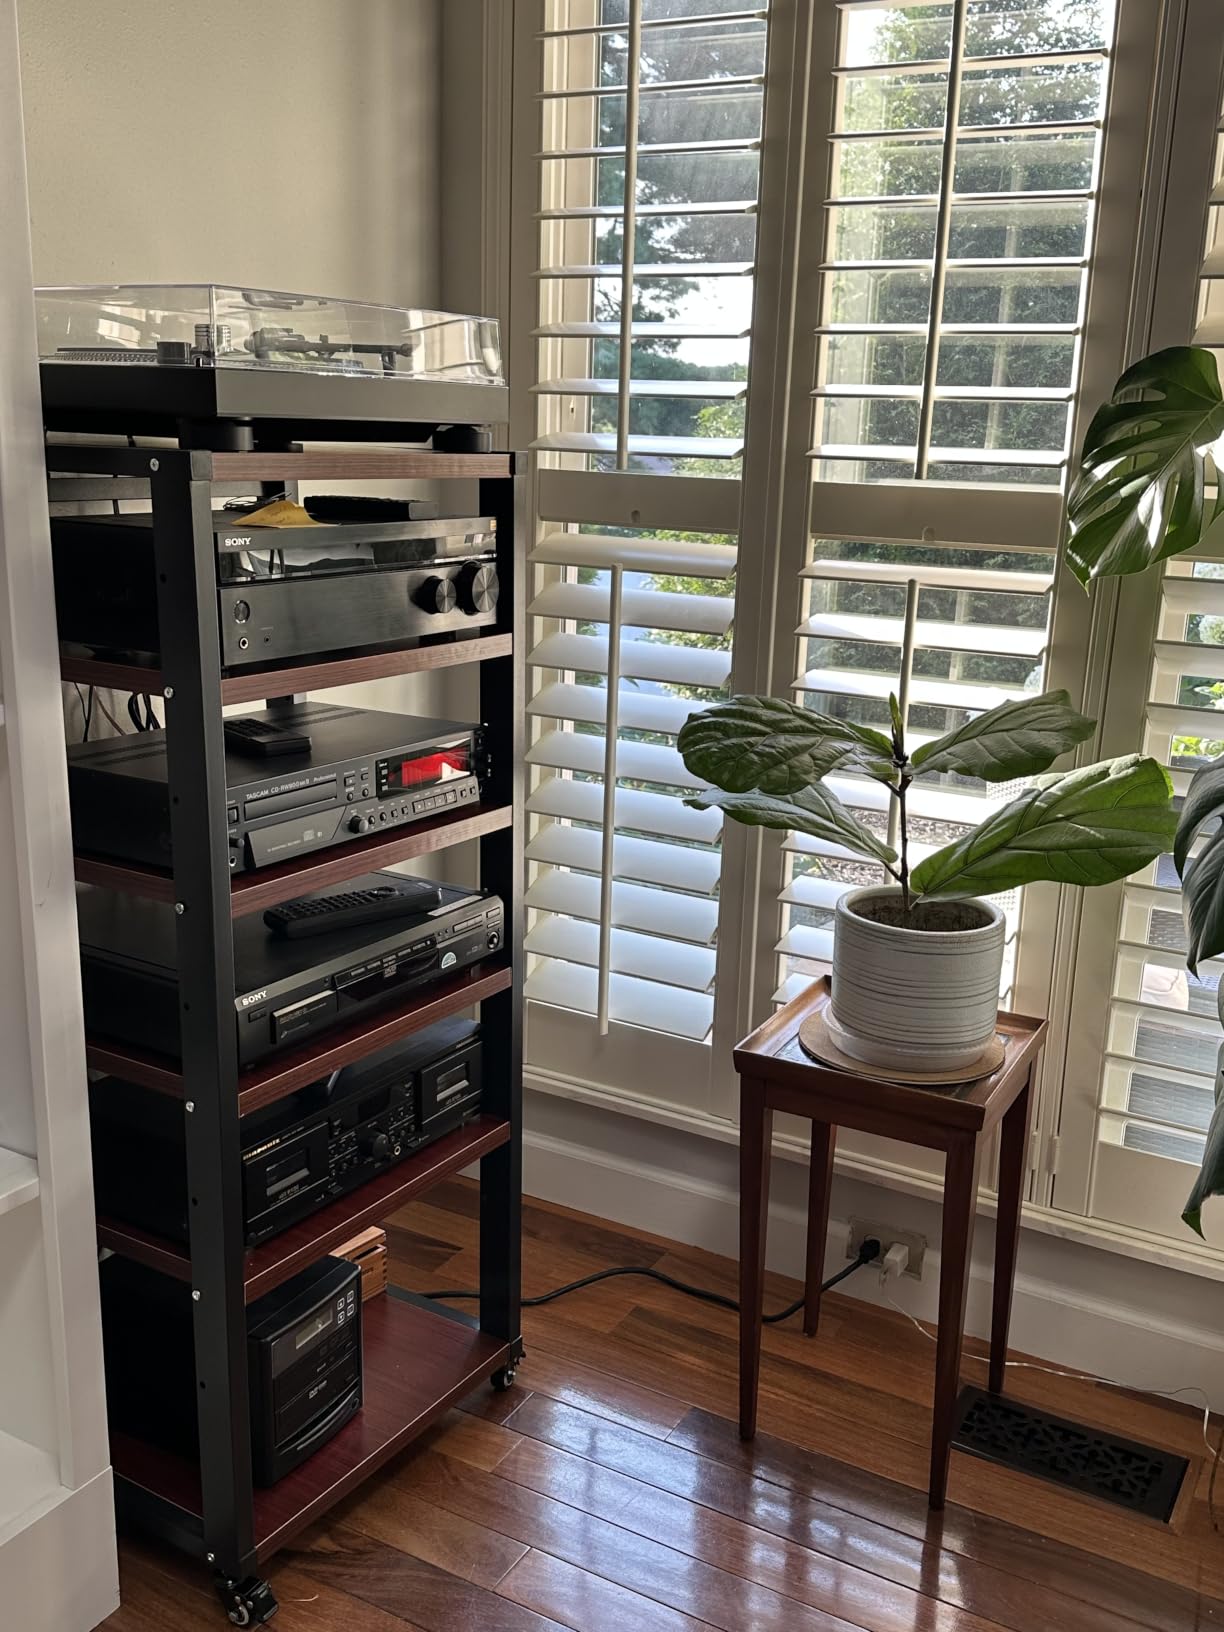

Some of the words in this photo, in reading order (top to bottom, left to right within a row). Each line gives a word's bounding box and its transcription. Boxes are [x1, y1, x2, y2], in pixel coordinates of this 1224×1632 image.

[224, 537, 251, 547] SONY
[246, 789, 269, 800] TASCAM
[241, 990, 267, 1006] SONY
